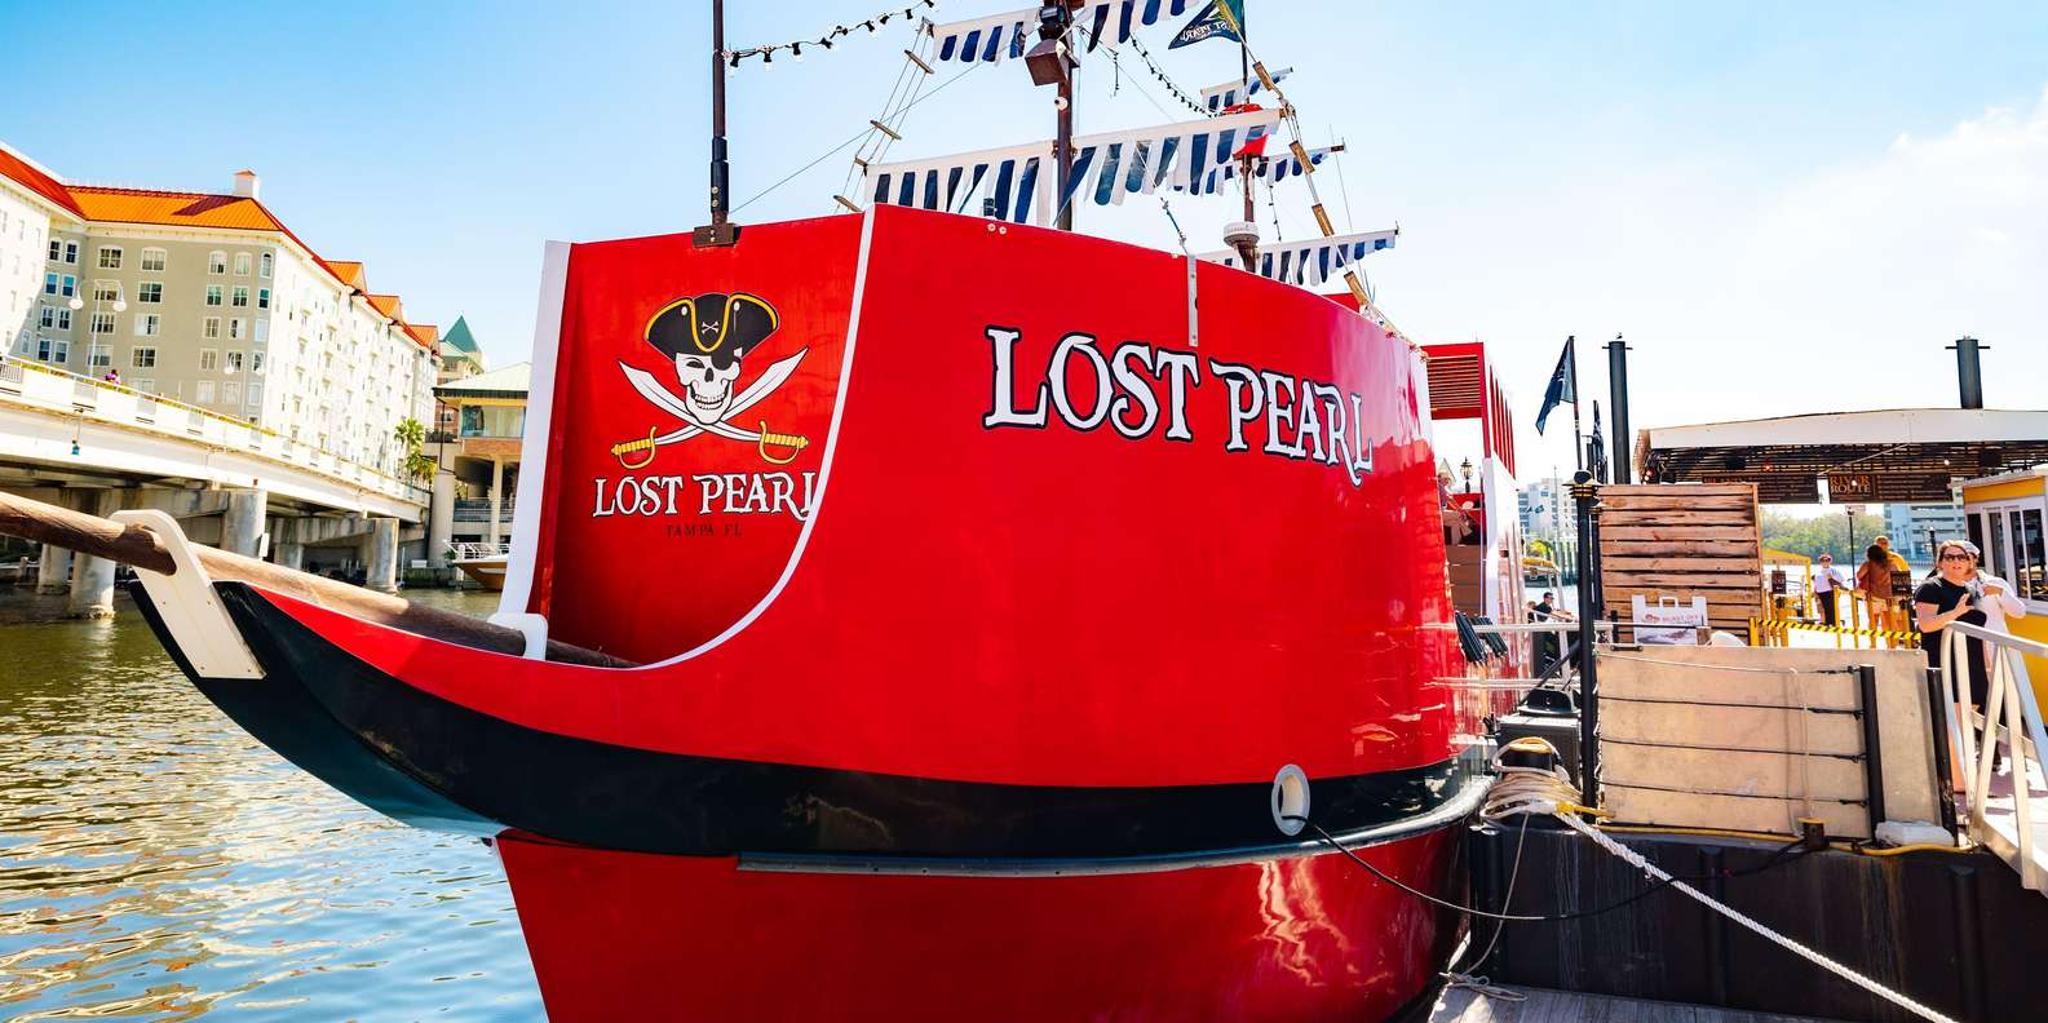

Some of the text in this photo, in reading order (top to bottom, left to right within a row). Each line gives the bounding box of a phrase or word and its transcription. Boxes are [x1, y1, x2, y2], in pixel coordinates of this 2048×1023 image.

[984, 325, 1373, 487] LOST PEARL
[592, 471, 816, 522] LOST PEARL
[1830, 485, 1871, 493] ROUTE
[666, 523, 743, 538] TAMPA FL
